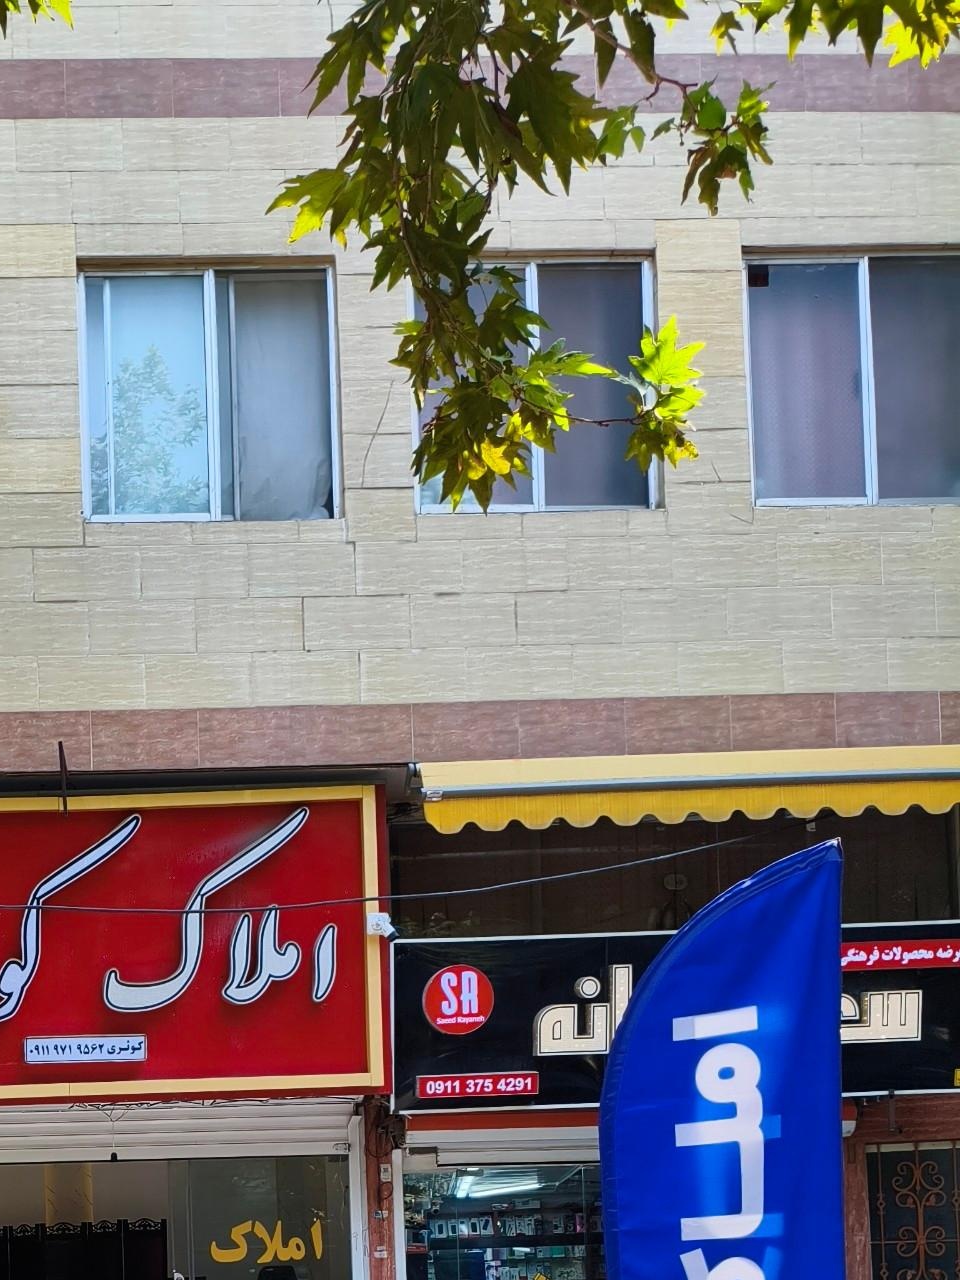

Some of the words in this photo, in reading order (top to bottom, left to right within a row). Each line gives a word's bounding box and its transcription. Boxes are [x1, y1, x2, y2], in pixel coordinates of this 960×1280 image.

[104, 806, 338, 1012] املاک
[881, 945, 934, 965] محصولات
[440, 970, 479, 1016] SA
[436, 1016, 456, 1025] Saeed
[29, 1043, 50, 1056] ۰۹۱۱
[53, 1043, 72, 1056] ۹۷۱
[76, 1043, 105, 1055] ۹۵۶۲
[426, 1080, 461, 1094] 0911
[465, 1079, 493, 1093] 375
[497, 1077, 532, 1092] 4291
[210, 1218, 324, 1264] املاک
